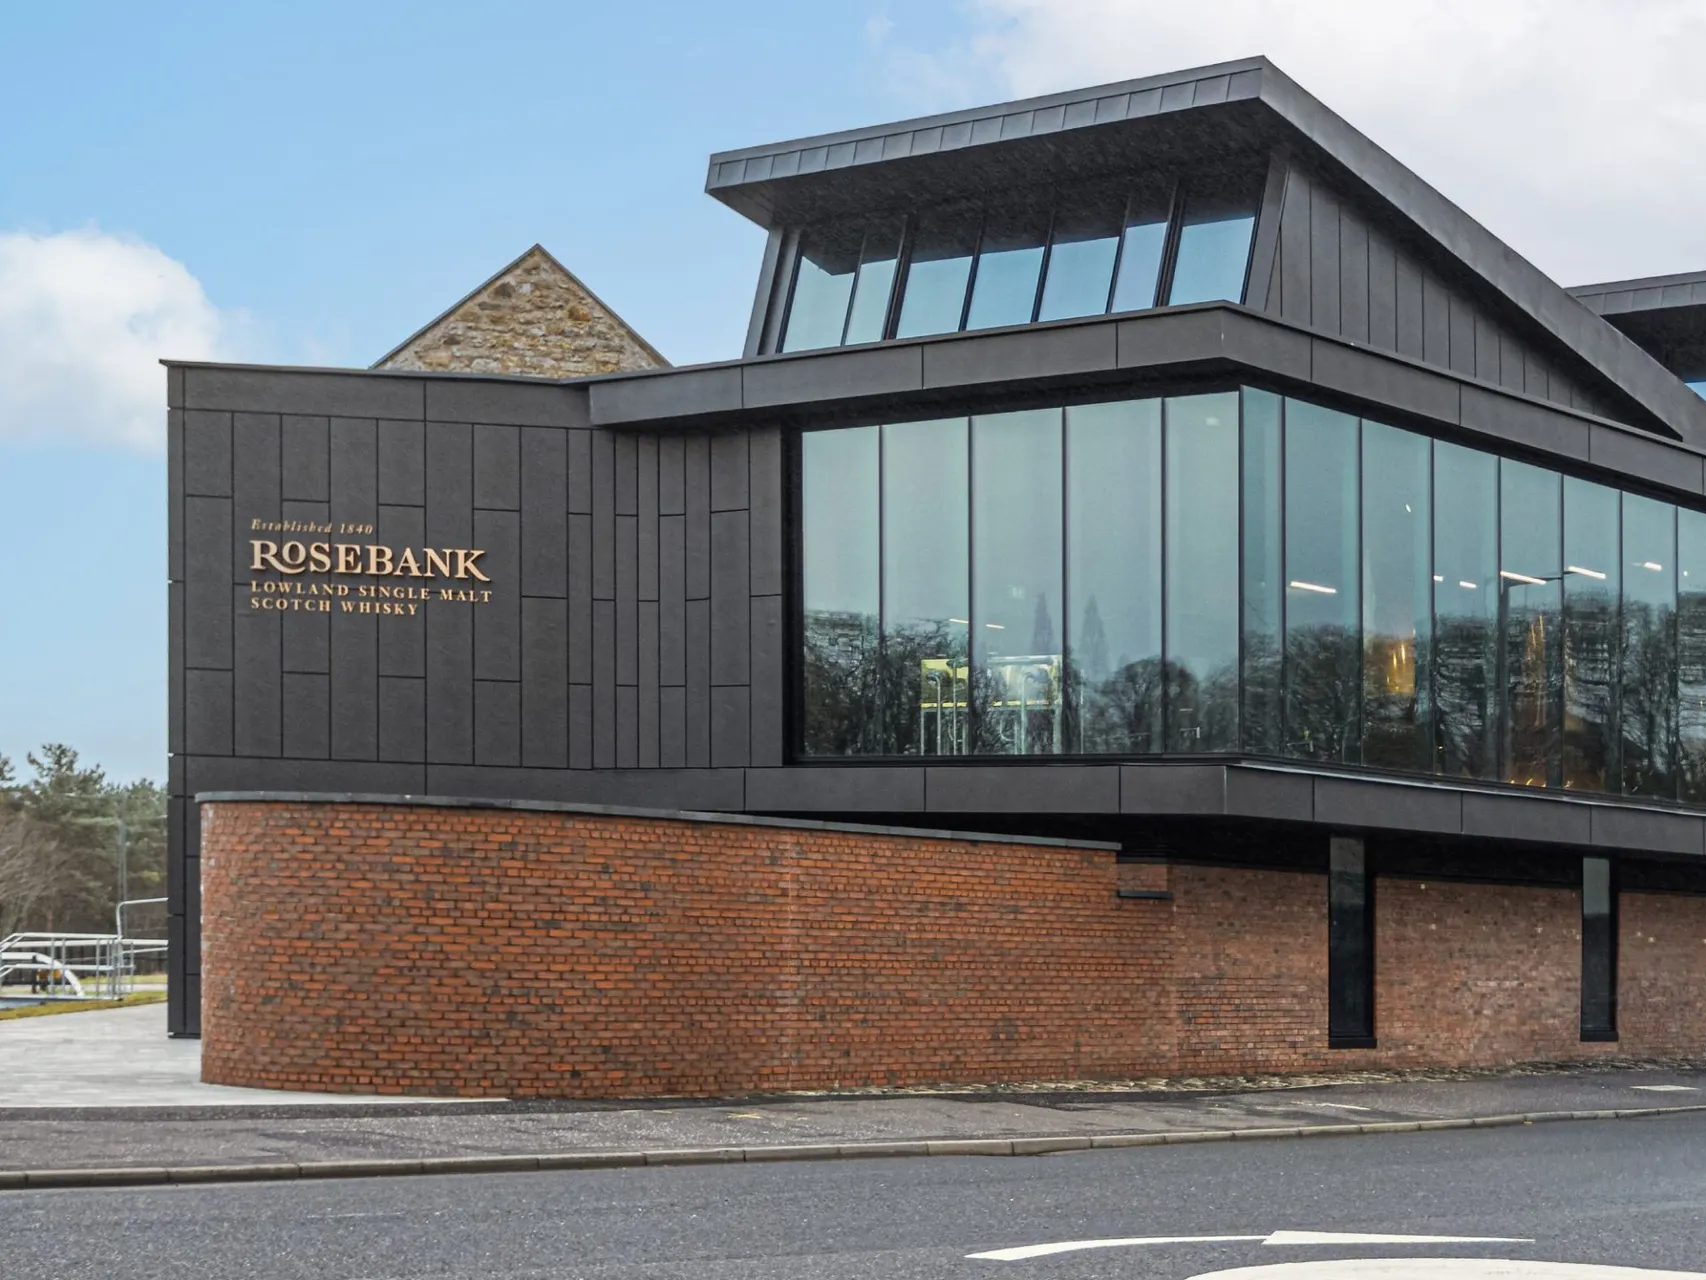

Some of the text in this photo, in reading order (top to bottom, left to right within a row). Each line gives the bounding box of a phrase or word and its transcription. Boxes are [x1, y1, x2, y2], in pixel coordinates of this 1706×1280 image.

[251, 518, 373, 534] Established 1840
[250, 540, 490, 582] ROSEBANK
[251, 580, 492, 602] LOWLAND SINGLE MALT
[251, 597, 418, 615] SCOTCH WHISKY
